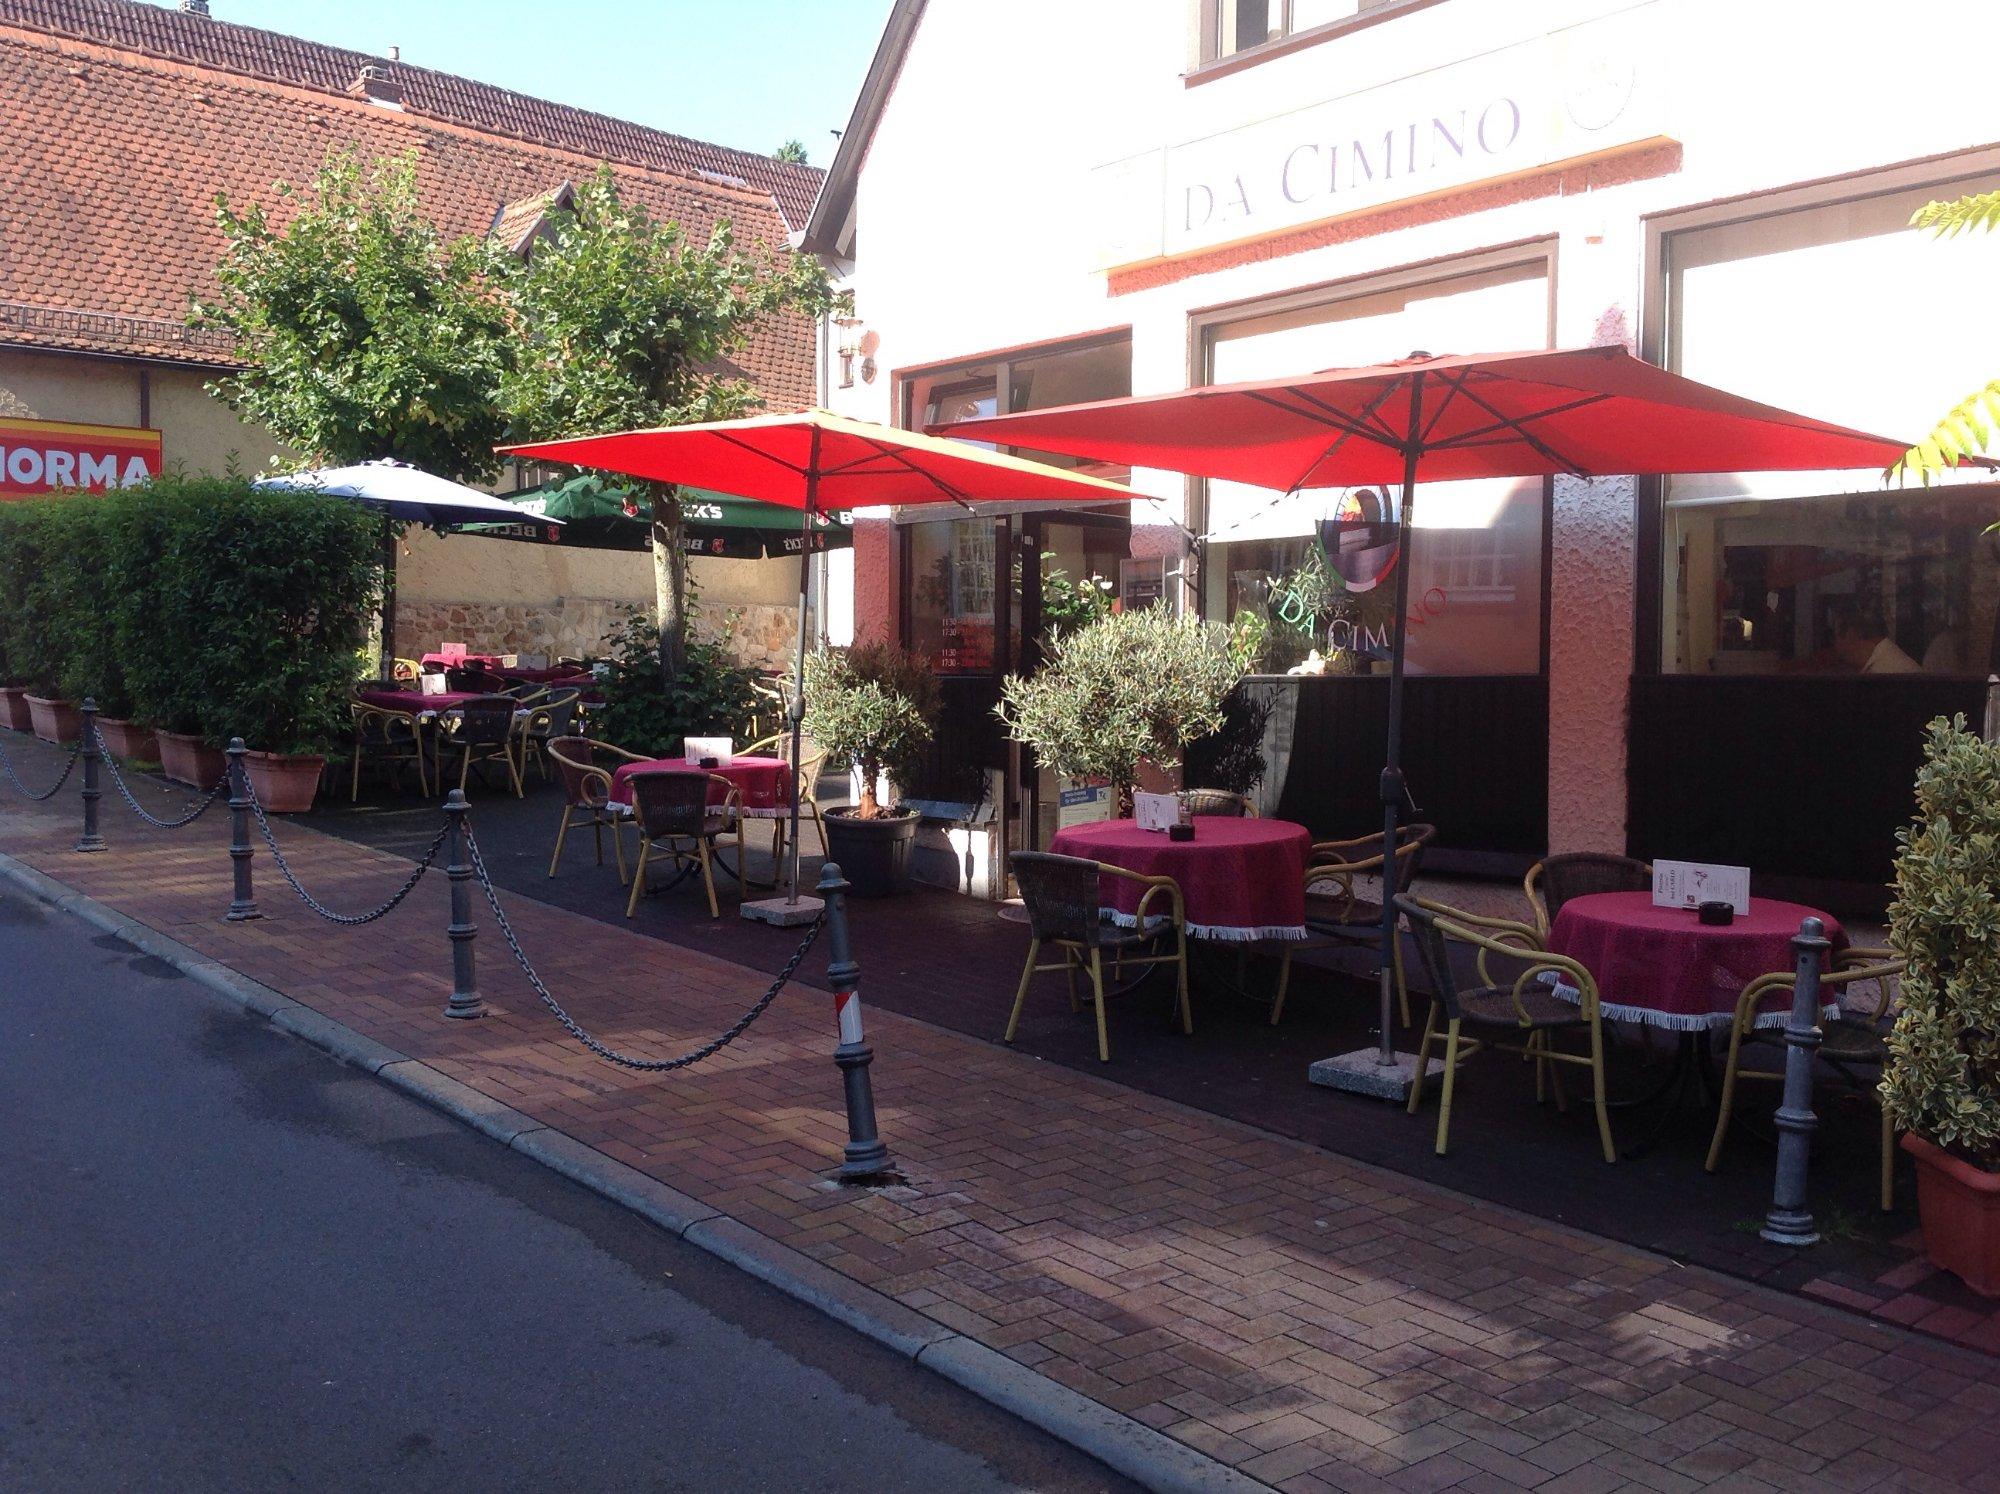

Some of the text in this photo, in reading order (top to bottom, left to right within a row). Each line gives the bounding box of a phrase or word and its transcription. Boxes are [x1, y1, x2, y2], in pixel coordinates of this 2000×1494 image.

[1185, 97, 1521, 231] DA CIMINO
[0, 446, 152, 490] ORMA
[1278, 587, 1447, 652] DA CIMNO
